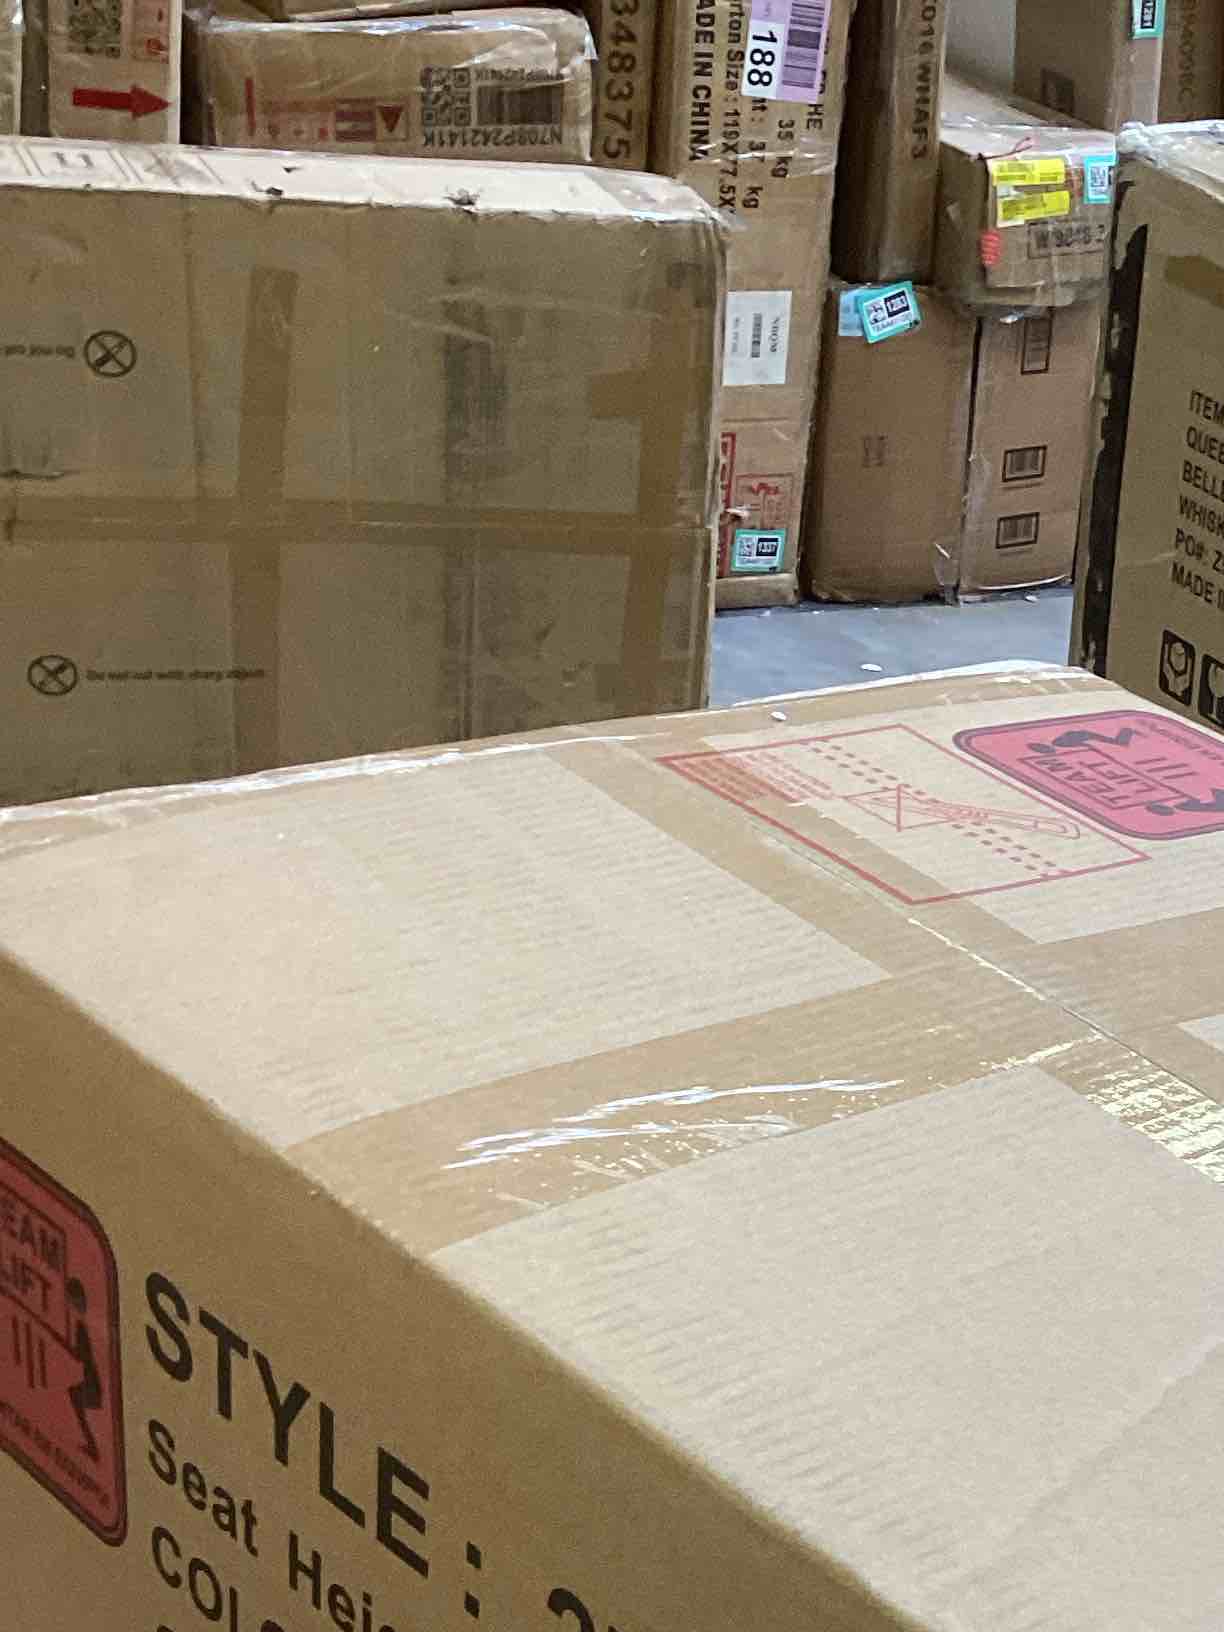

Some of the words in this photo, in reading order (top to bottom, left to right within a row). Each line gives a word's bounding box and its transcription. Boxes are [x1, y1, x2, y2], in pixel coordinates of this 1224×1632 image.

[696, 0, 715, 44] ADE
[728, 0, 746, 46] rton
[603, 0, 639, 158] 348375
[693, 52, 714, 78] IN
[747, 30, 778, 87] 188
[689, 85, 711, 162] CHINA
[771, 156, 790, 179] kg
[742, 186, 763, 209] kg
[1171, 563, 1214, 604] MADE
[1035, 758, 1131, 803] TEAM
[1080, 760, 1157, 793] LIFT
[0, 1196, 64, 1272] EAM
[147, 1419, 258, 1558] Seat
